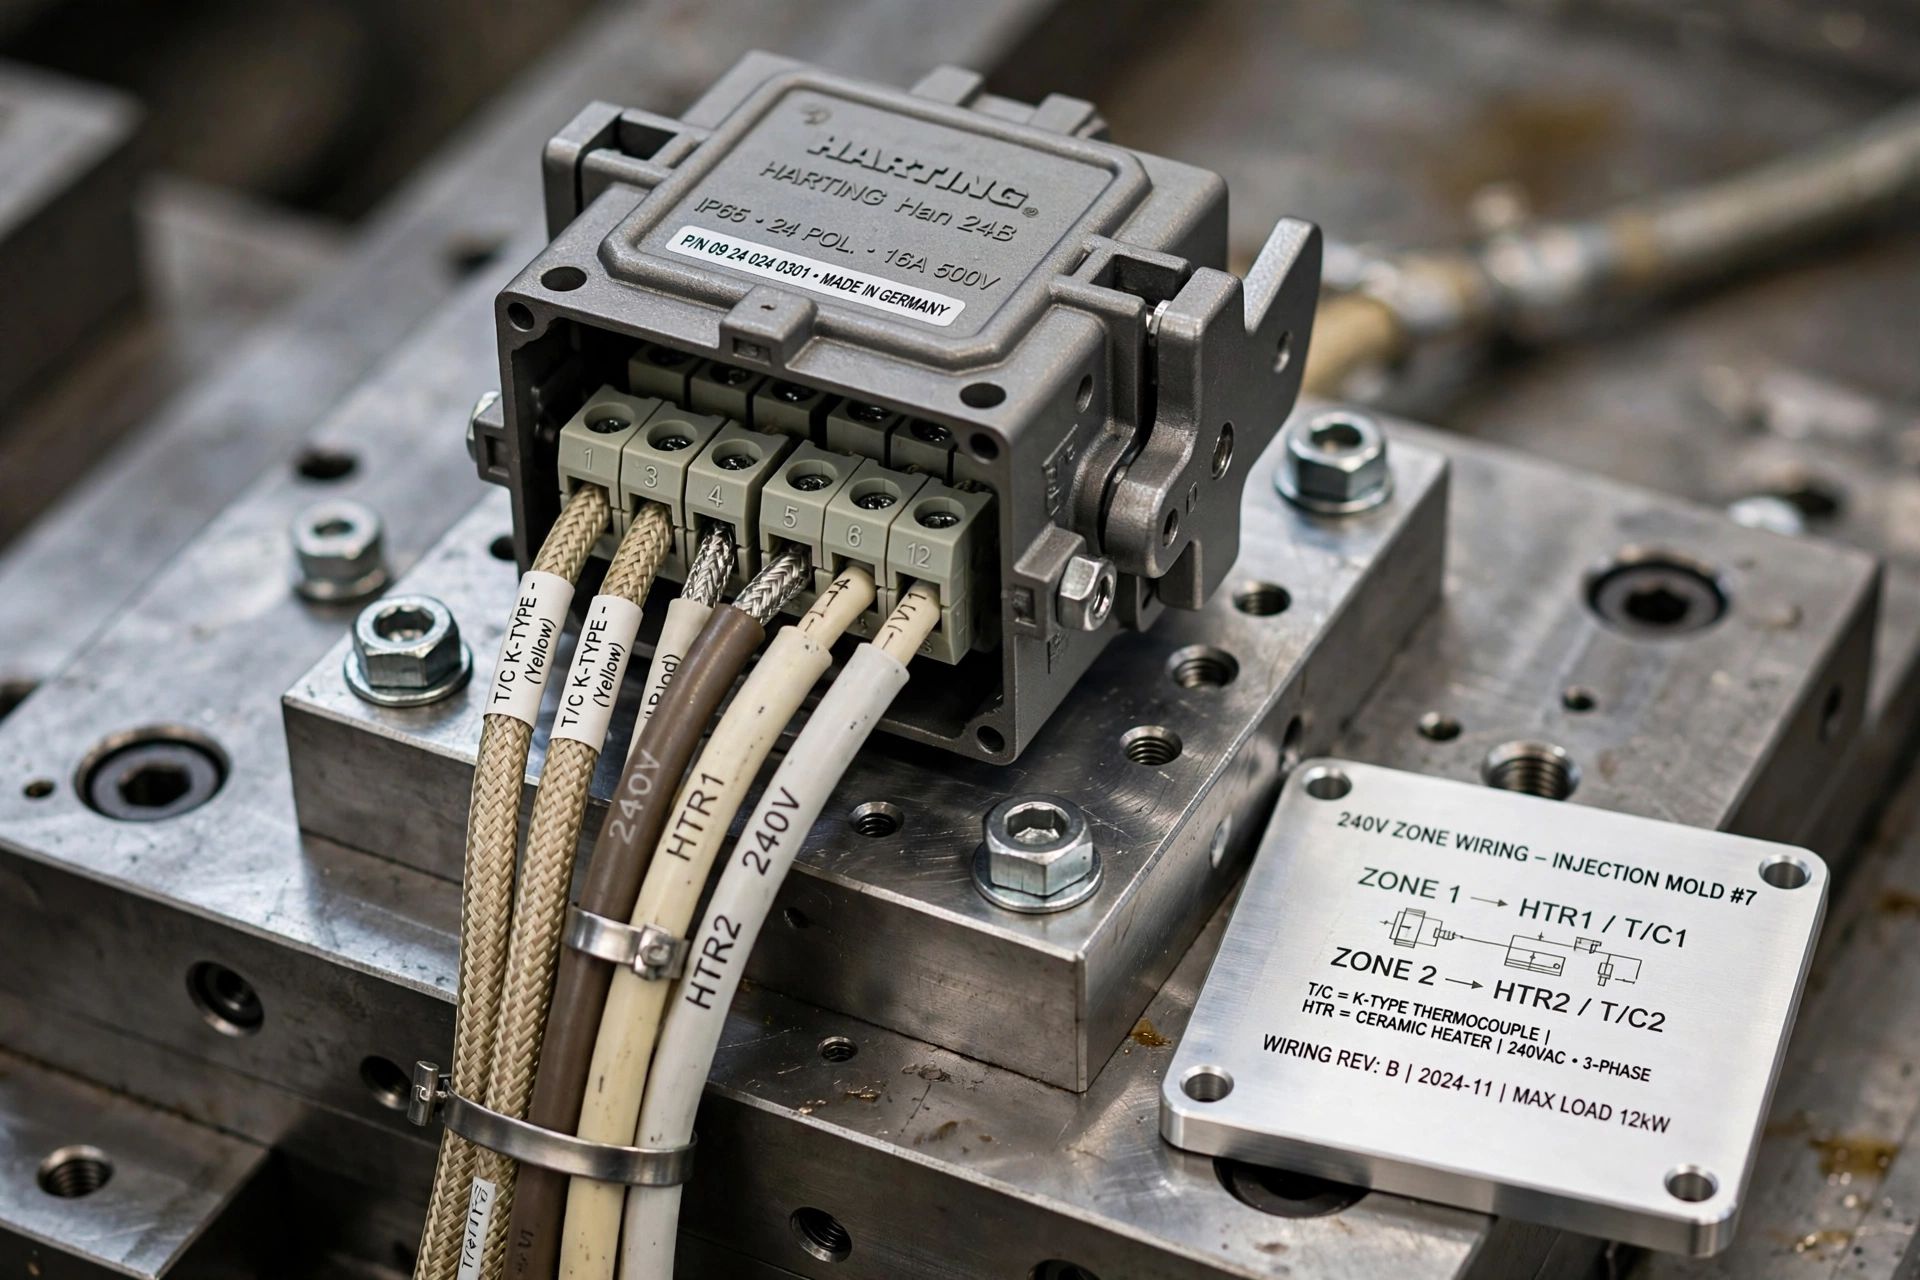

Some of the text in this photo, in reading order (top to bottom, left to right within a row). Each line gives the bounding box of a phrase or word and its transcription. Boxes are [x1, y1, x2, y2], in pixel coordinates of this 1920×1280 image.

[759, 161, 1018, 242] HARTING Han 24B
[681, 234, 710, 252] P/N
[708, 242, 729, 256] 09
[727, 248, 749, 262] 24
[748, 253, 776, 269] 024
[775, 260, 811, 279] 0301
[819, 272, 864, 294] MADE
[861, 284, 877, 298] IN
[879, 289, 951, 317] GERMANY
[694, 197, 752, 223] IP65
[766, 218, 801, 238] 24
[802, 227, 854, 254] POL.
[885, 249, 928, 274] 16A
[933, 263, 1001, 291] 500V
[584, 448, 594, 471] 1
[644, 465, 659, 488] 3
[707, 484, 723, 508] 4
[783, 505, 799, 528] 5
[847, 524, 863, 547] 6
[907, 542, 932, 569] 12
[503, 596, 537, 664] K-TYPE
[524, 618, 557, 685] (Yellow)
[572, 619, 608, 688] K-TYPE
[493, 669, 516, 704] T/C
[593, 642, 626, 708] (Yellow)
[561, 693, 584, 728] T/C
[608, 748, 661, 844] 240V
[666, 772, 725, 862] HTR1
[1338, 811, 1389, 834] 240V
[1392, 821, 1450, 847] ZONE
[1455, 832, 1529, 862] WIRING
[1552, 852, 1660, 888] INJECTION
[1665, 874, 1725, 900] MOLD
[1729, 887, 1758, 906] #7
[685, 786, 800, 1010] HTR2 240V
[1358, 867, 1440, 899] ZONE
[1449, 884, 1461, 904] 1
[1518, 897, 1592, 930] HTR1
[1625, 917, 1687, 948] T/C1
[1307, 981, 1334, 999] T/C
[1352, 991, 1410, 1015] K-TYPE
[1408, 1002, 1540, 1042] THERMOCOUPLE
[1330, 946, 1413, 981] ZONE
[1418, 964, 1437, 986] 2
[1493, 979, 1571, 1014] HTR2
[1600, 1000, 1666, 1033] T/C2
[1302, 998, 1335, 1018] HTR
[1355, 1010, 1428, 1036] CERAMIC
[1431, 1024, 1493, 1050] HEATER
[1507, 1041, 1567, 1065] 240VAC
[1582, 1056, 1652, 1083] 3-PHASE
[1262, 1034, 1333, 1064] WIRING
[1336, 1049, 1380, 1074] REV:
[1385, 1059, 1400, 1078] B
[1418, 1067, 1493, 1097] 2024-11
[1512, 1086, 1556, 1111] MAX
[1560, 1096, 1613, 1122] LOAD
[1620, 1108, 1671, 1134] 12kW
